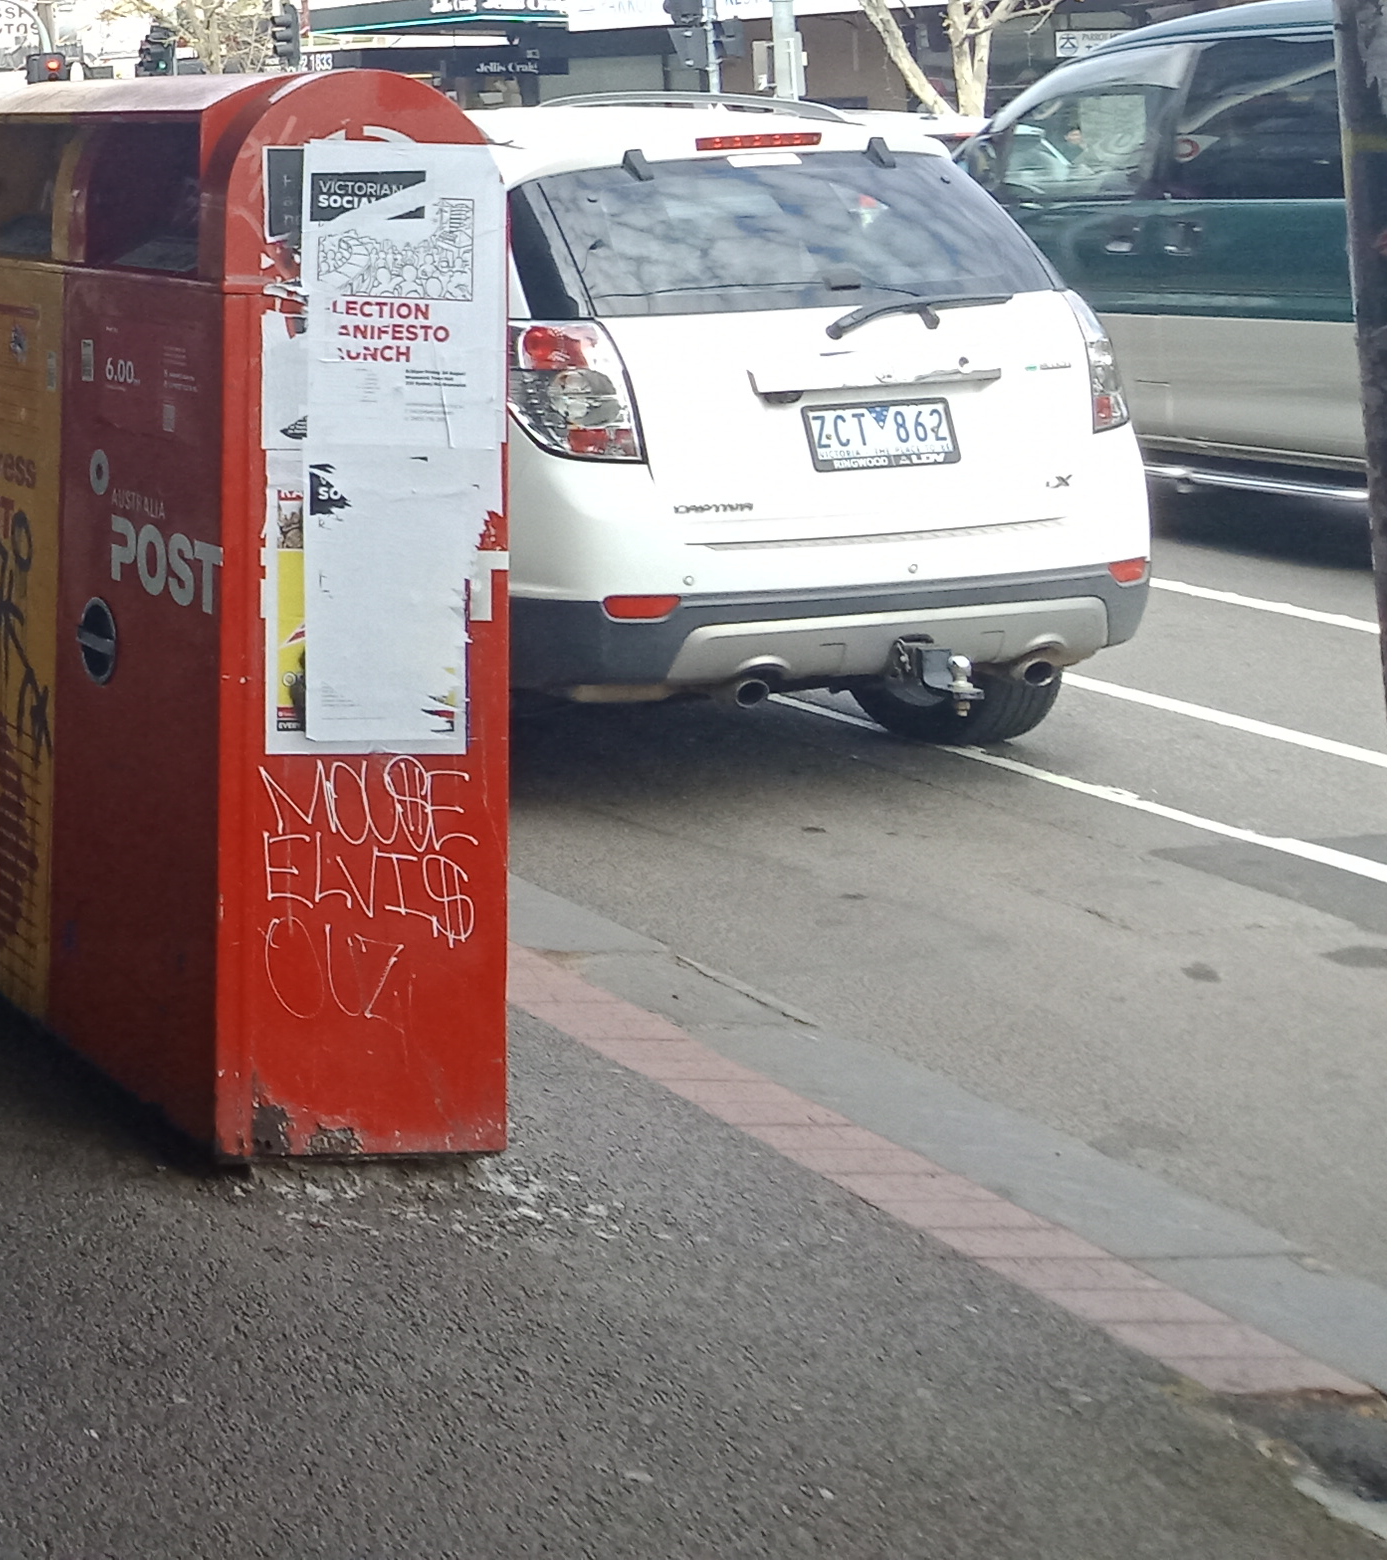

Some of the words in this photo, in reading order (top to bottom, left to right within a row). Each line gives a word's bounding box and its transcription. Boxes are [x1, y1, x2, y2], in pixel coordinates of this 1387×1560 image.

[326, 300, 430, 320] LECTION
[338, 324, 450, 342] ANIFESTO
[812, 412, 867, 449] ZCT
[894, 409, 948, 443] 862
[833, 456, 889, 469] RINGWOOD
[111, 489, 166, 521] AUSTRALIA
[111, 514, 224, 615] POST
